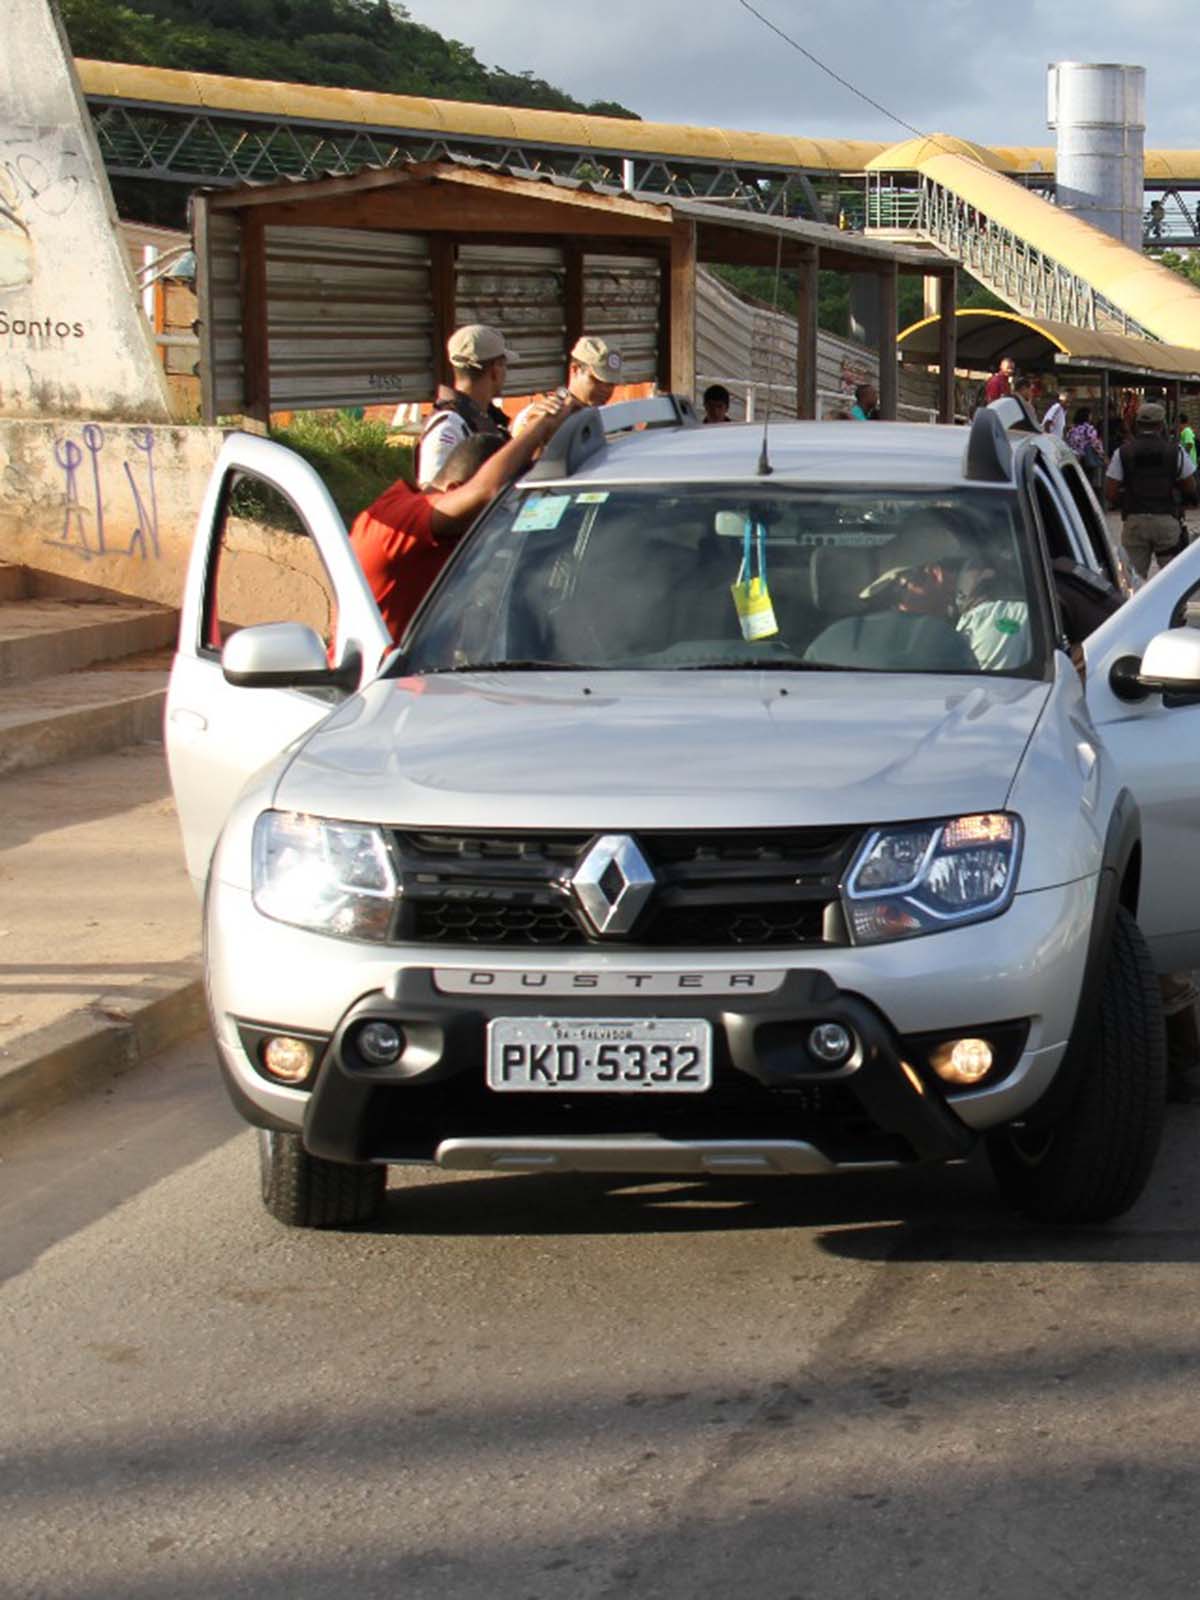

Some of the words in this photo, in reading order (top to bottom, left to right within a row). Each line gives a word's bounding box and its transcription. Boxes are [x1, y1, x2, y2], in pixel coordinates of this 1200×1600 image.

[0, 311, 84, 337] Santos
[469, 973, 755, 988] DUSTER
[580, 1029, 633, 1040] SALVADOR
